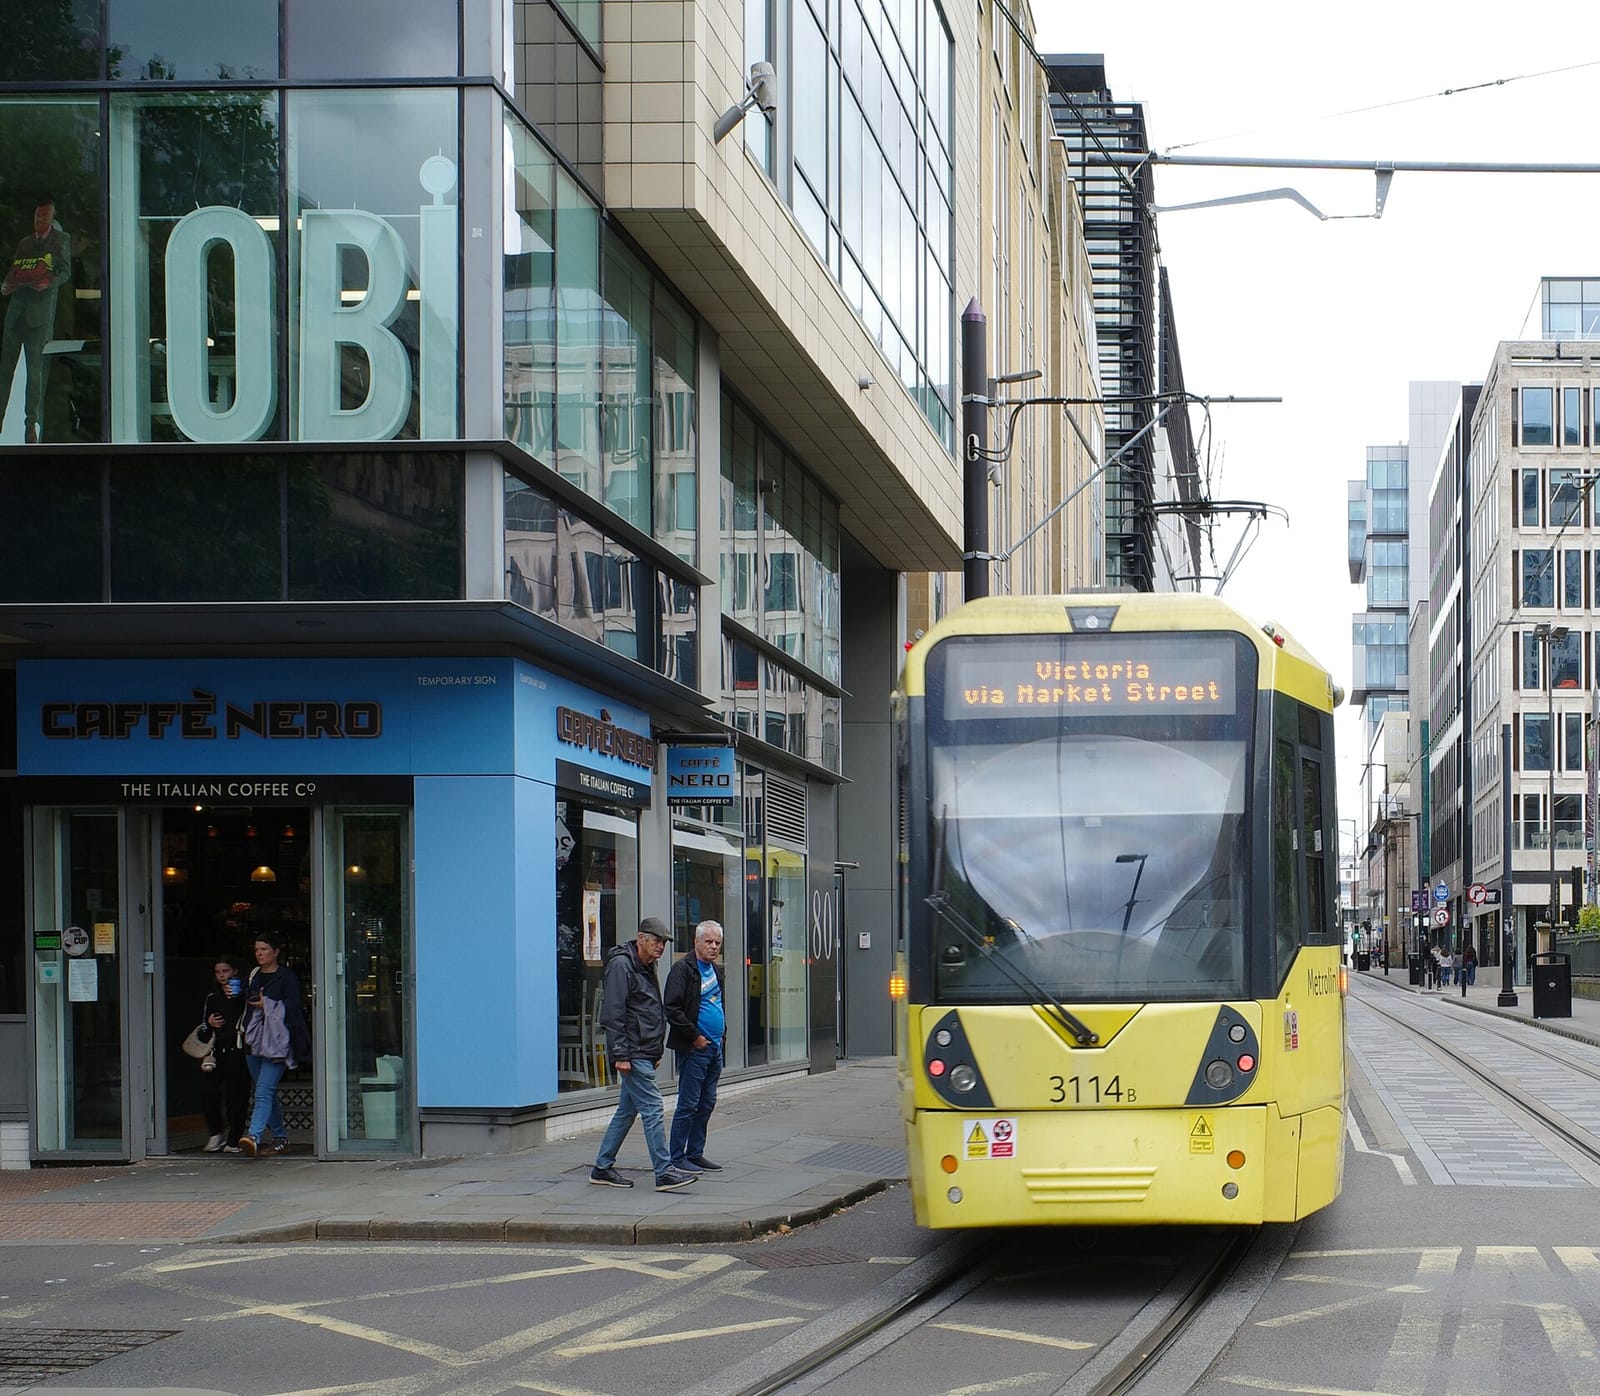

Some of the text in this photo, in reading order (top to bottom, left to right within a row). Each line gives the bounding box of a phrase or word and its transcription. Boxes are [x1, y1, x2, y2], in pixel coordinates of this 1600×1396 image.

[417, 675, 496, 686] TEMPORARY SIGN
[1036, 660, 1150, 681] Victoria
[964, 682, 1220, 704] via Market Street
[226, 701, 382, 739] NERO
[121, 784, 151, 796] THE
[157, 783, 222, 796] ITALIAN
[228, 783, 288, 796] COFFEE
[580, 773, 590, 787] THE
[590, 776, 610, 791] ITALIAN
[610, 782, 627, 797] COFFEE
[670, 774, 730, 787] NERO
[813, 889, 832, 960] 80
